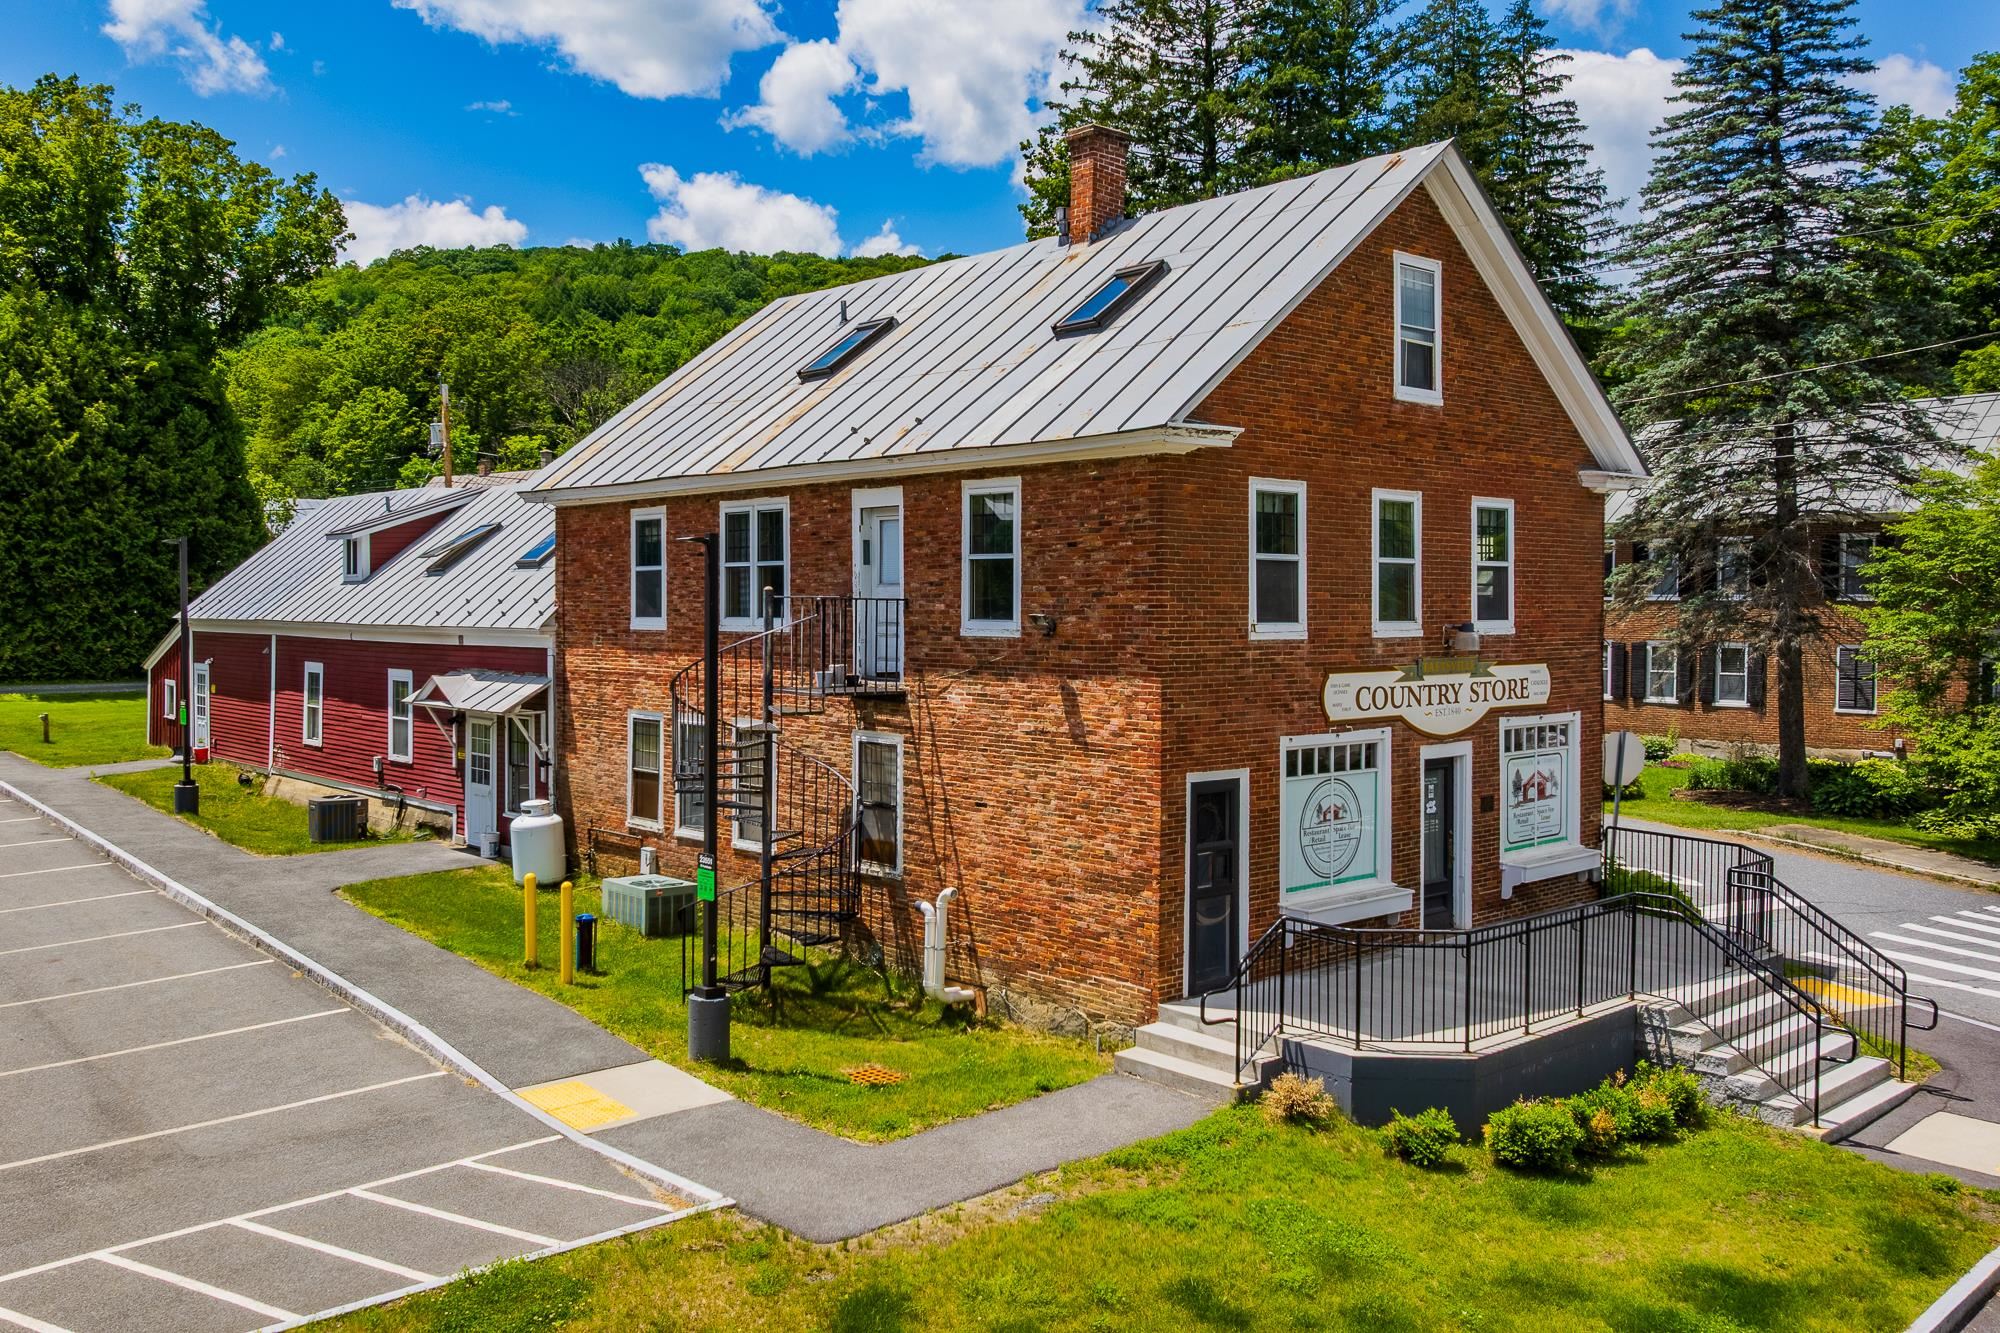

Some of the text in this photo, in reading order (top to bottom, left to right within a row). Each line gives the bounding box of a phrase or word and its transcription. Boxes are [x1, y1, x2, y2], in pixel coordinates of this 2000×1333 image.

[1355, 677, 1530, 712] COUNTRY STORE
[1303, 828, 1330, 836] Restaurant
[1338, 831, 1352, 839] Lease
